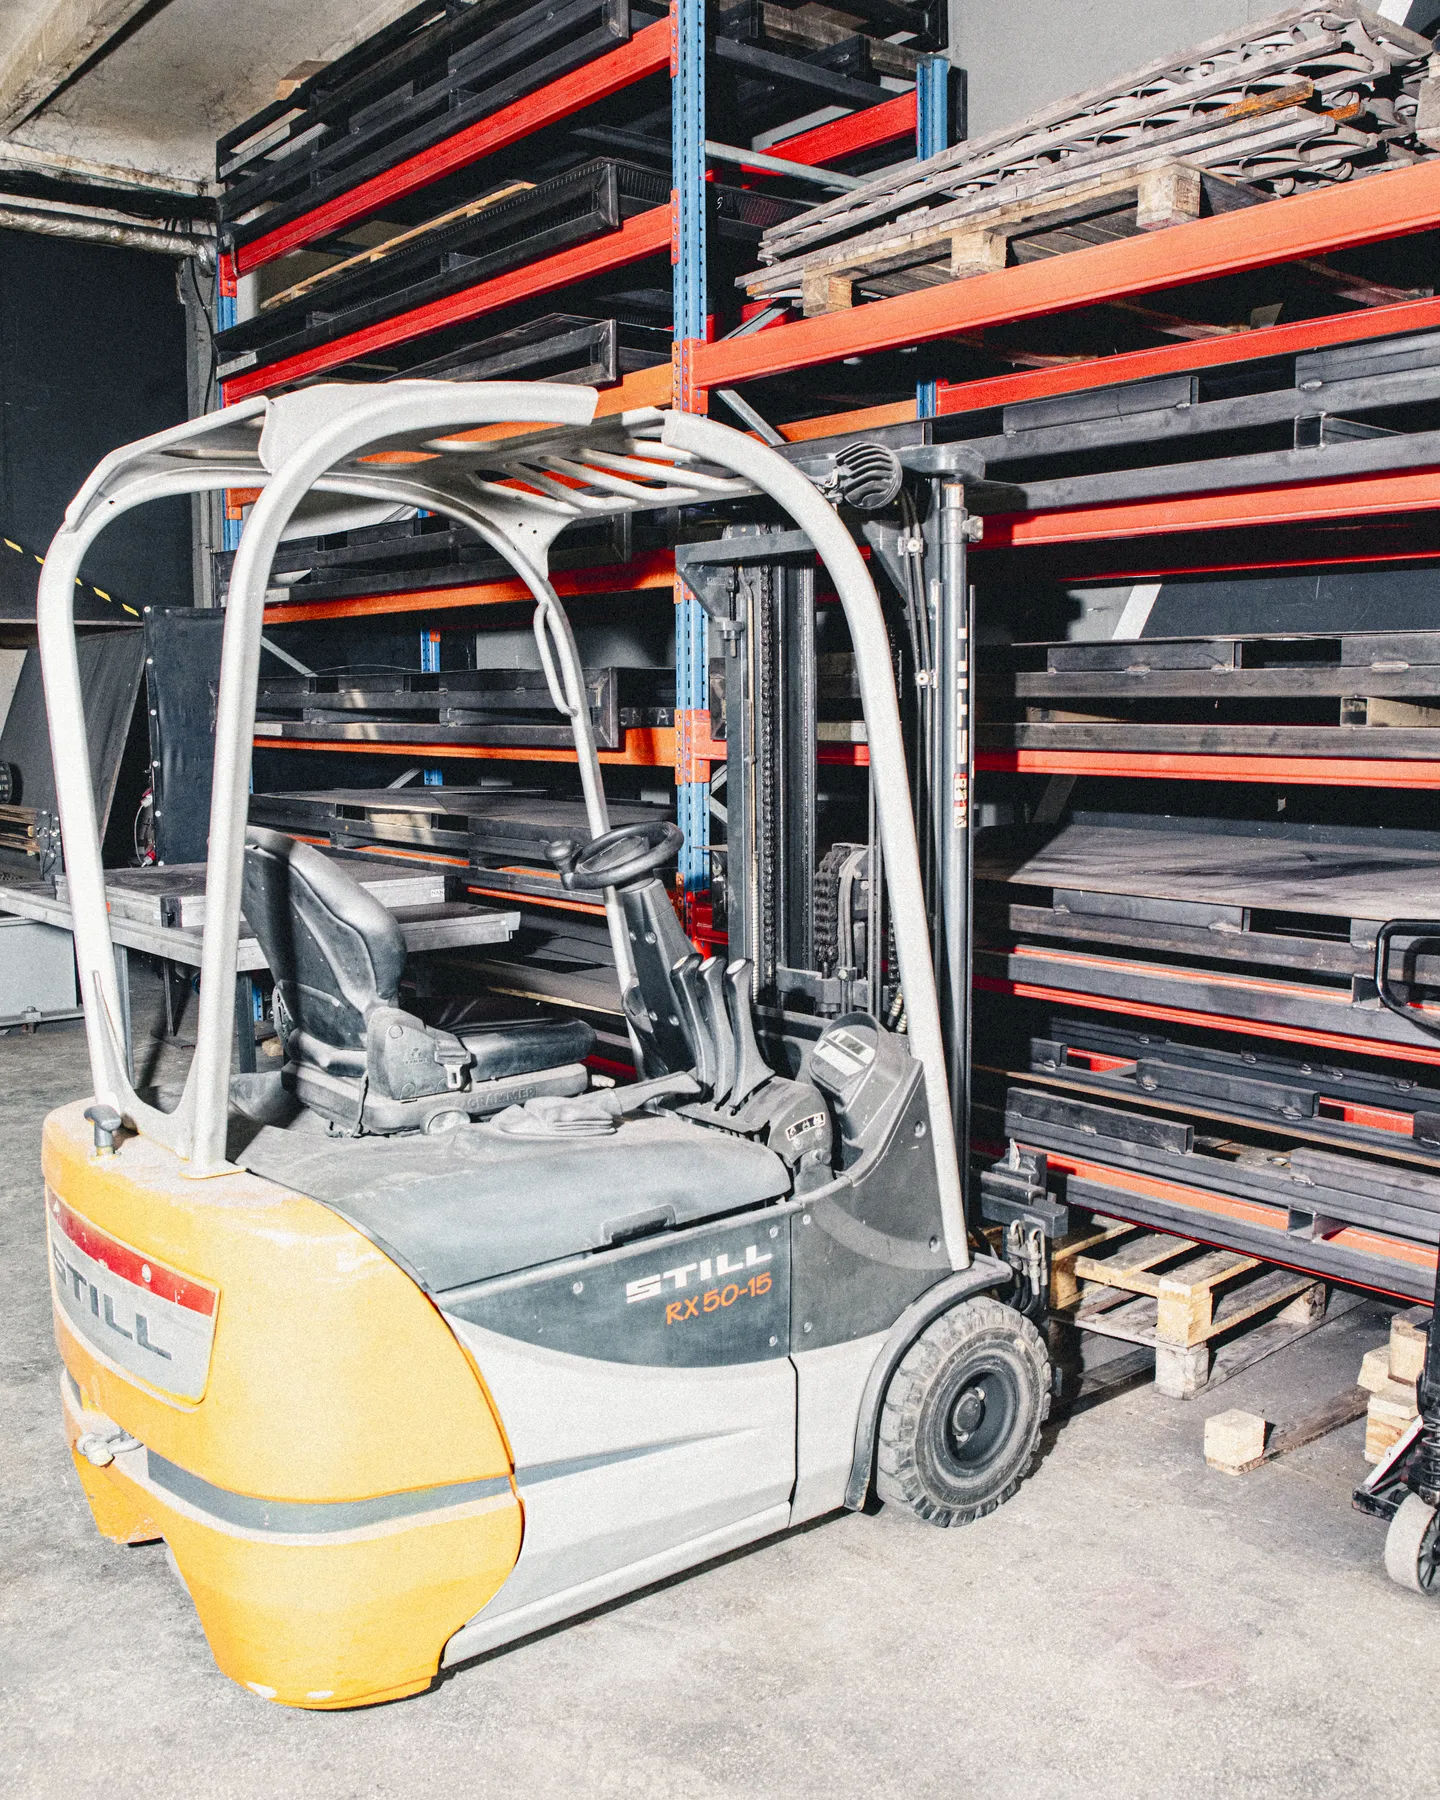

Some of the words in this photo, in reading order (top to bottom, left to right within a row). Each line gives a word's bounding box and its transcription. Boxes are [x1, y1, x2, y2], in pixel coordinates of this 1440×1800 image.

[52, 1240, 172, 1361] STILL
[626, 1244, 773, 1304] STILL
[665, 1295, 700, 1325] RX
[703, 1271, 773, 1313] 50-15
